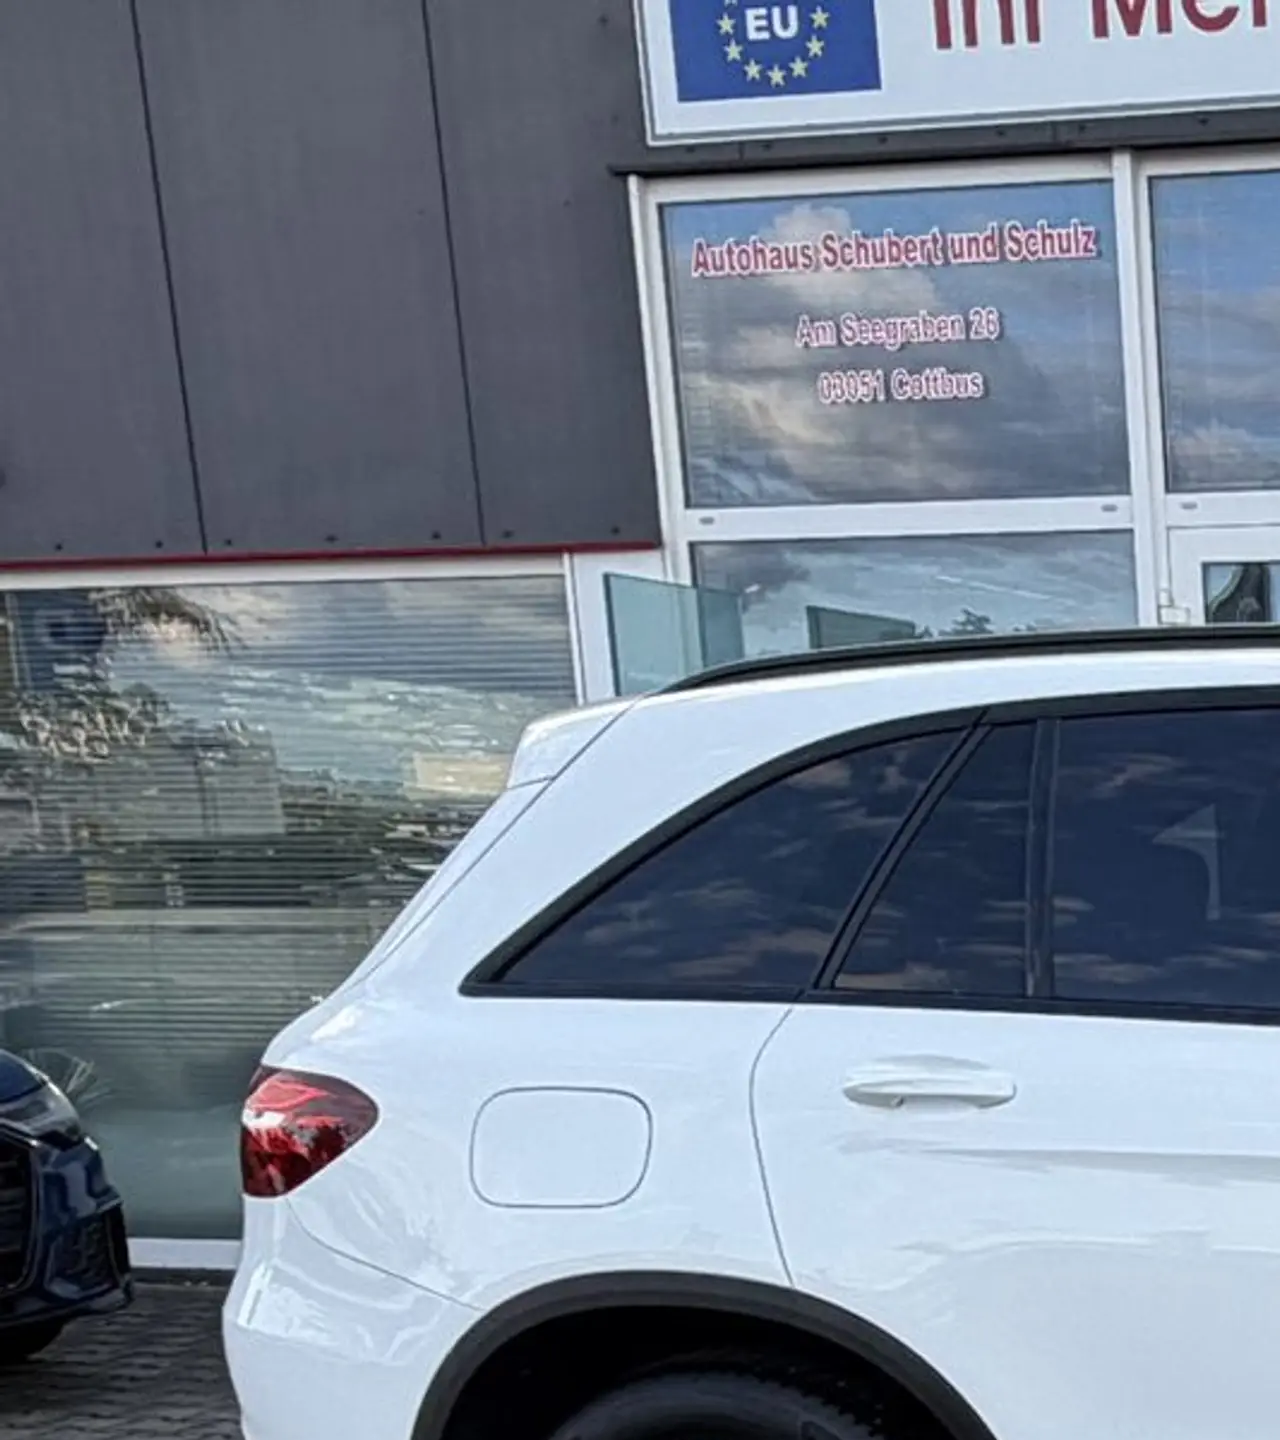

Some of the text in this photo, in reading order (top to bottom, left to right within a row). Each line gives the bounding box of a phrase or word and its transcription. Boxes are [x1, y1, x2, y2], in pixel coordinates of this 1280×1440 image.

[745, 5, 798, 41] EU
[692, 219, 1097, 278] Autohaus Schubert und Schulz
[796, 306, 1001, 352] Am Seegraben 26
[891, 367, 985, 402] Cottbus
